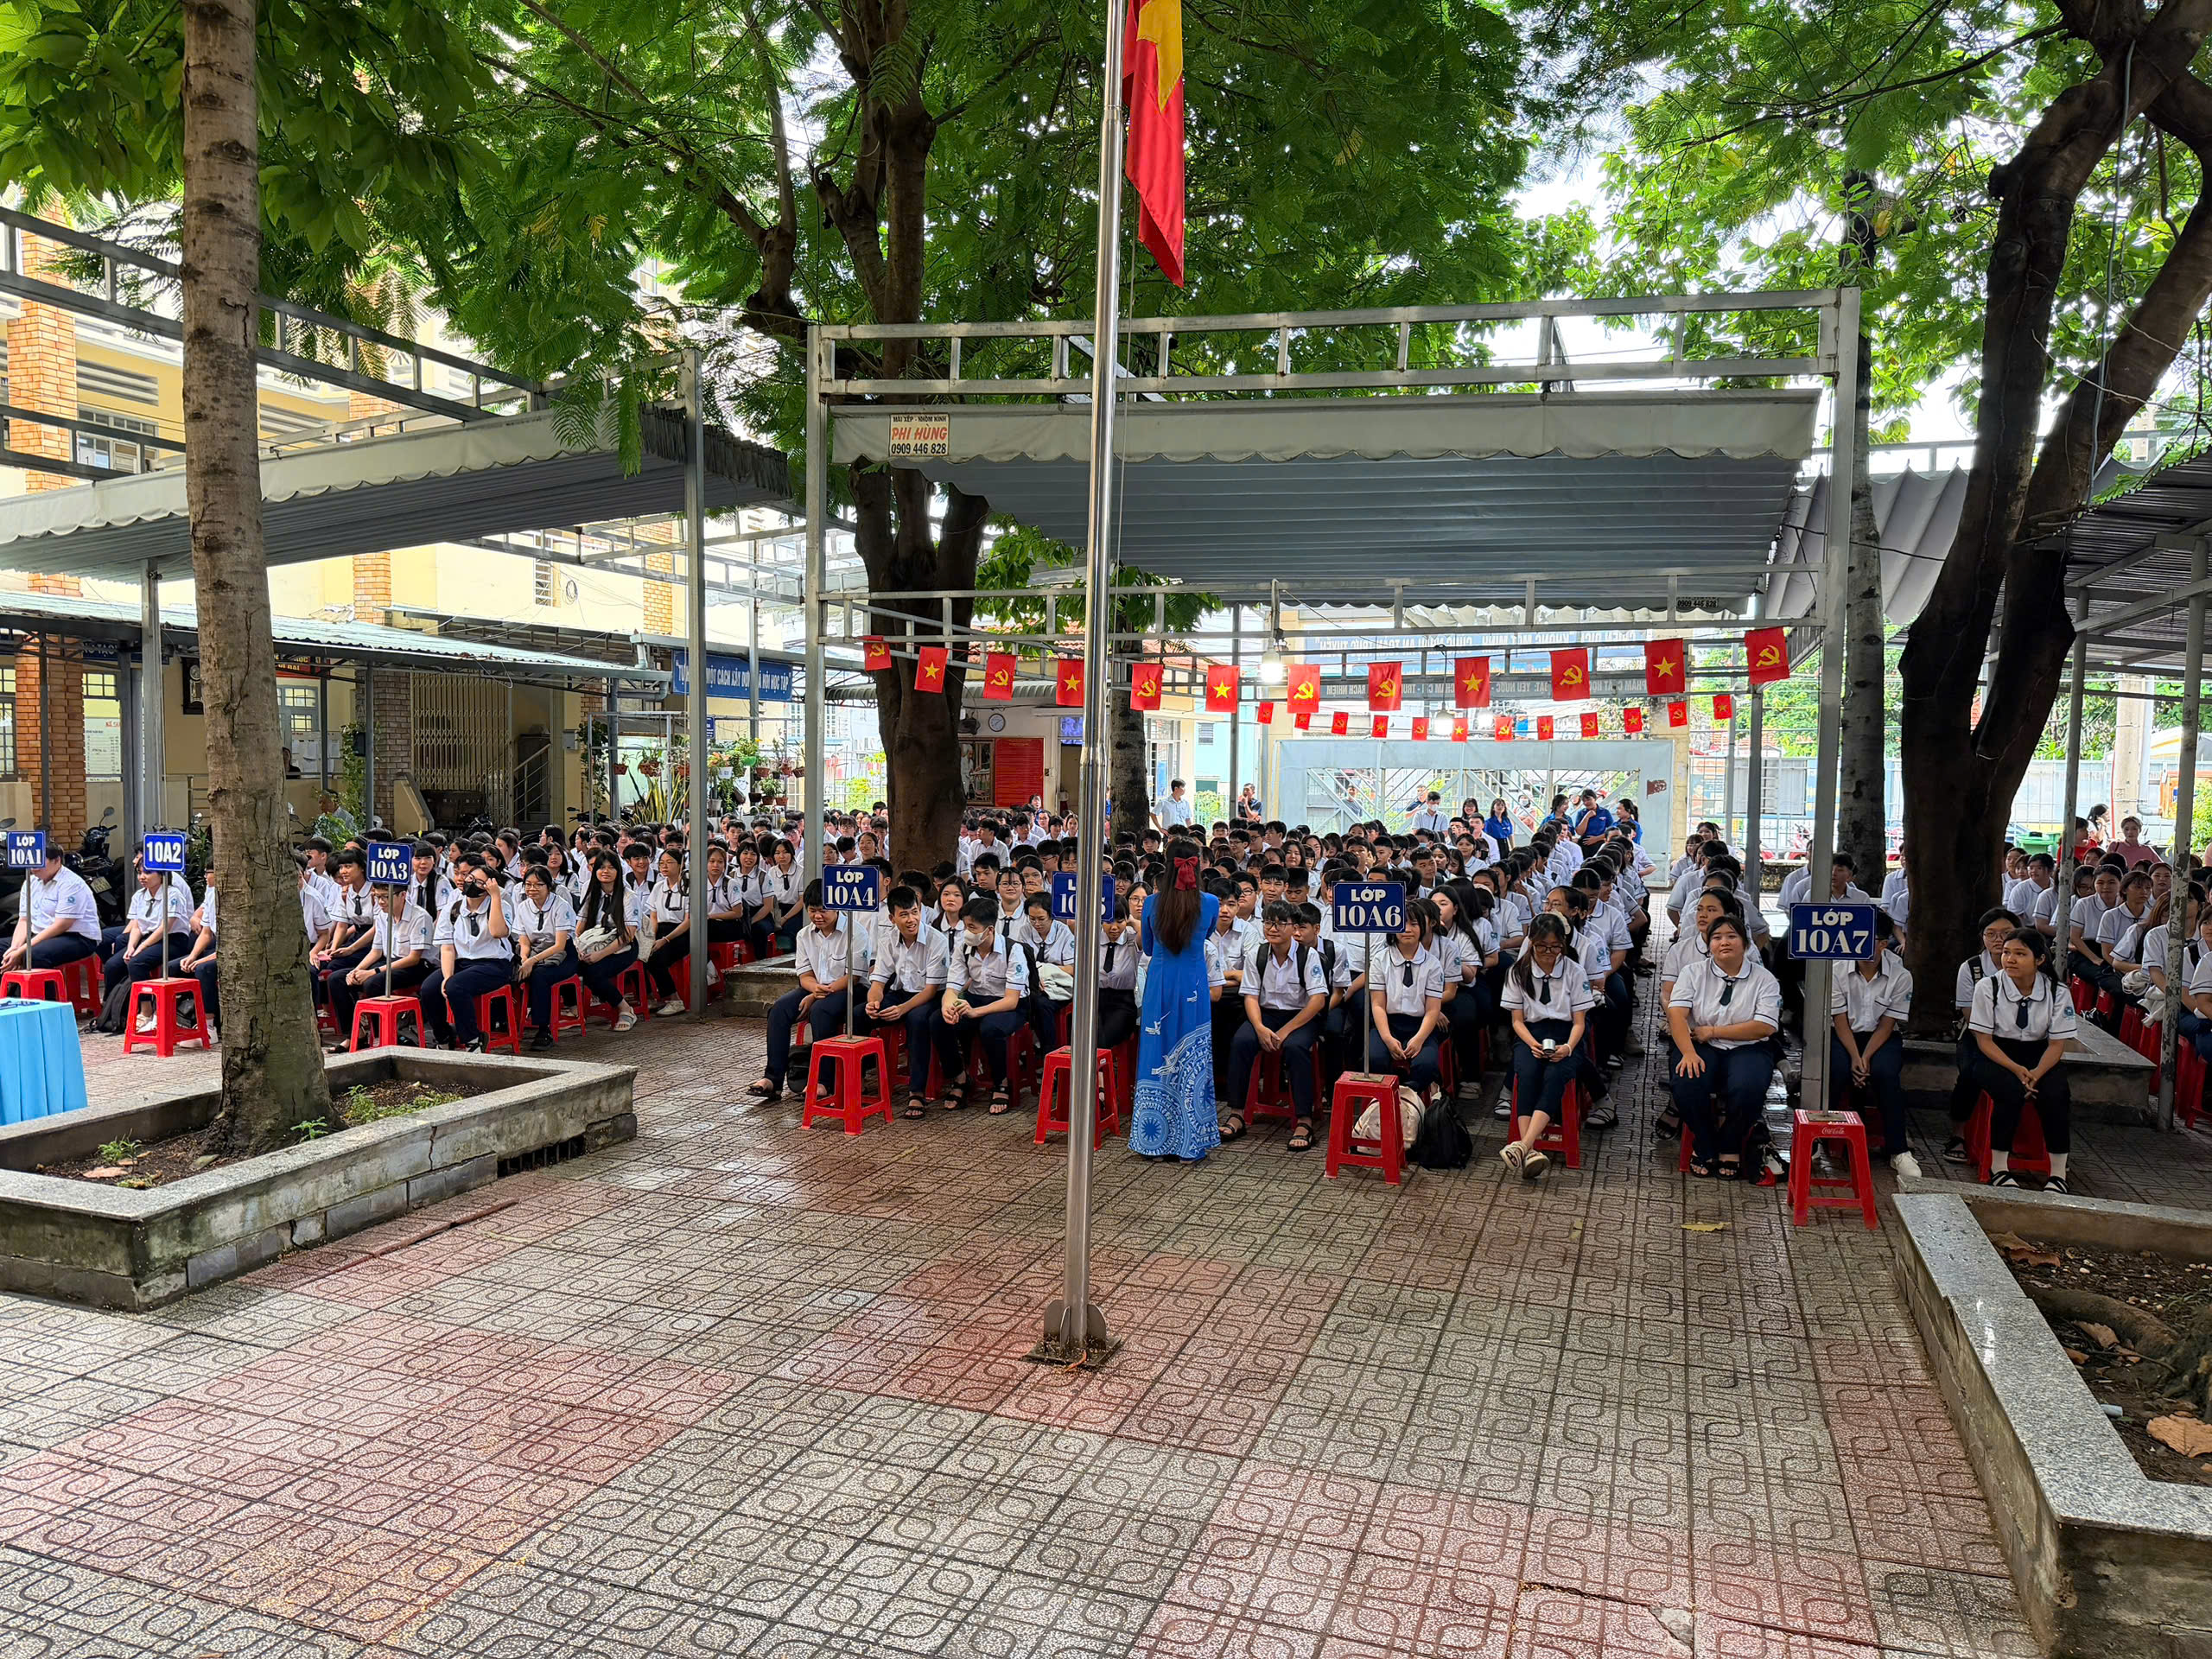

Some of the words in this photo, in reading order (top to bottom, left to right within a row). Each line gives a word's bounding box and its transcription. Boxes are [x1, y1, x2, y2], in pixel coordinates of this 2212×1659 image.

[891, 427, 912, 441] PHI
[913, 423, 948, 441] HÙNG
[891, 442, 912, 454] 0909
[912, 442, 929, 454] 446
[931, 442, 947, 454] 828
[16, 833, 36, 847] LỚP
[10, 848, 42, 866] 10A1
[146, 841, 182, 864] 10A2
[378, 846, 400, 860] LỚP
[370, 860, 408, 880] 10A3
[836, 868, 865, 884] LỚP
[825, 885, 876, 906] 10A4
[1351, 886, 1387, 902] LỚP
[1336, 905, 1402, 927] 10A6
[1811, 908, 1854, 926] LỚP
[1796, 929, 1870, 954] 10A7
